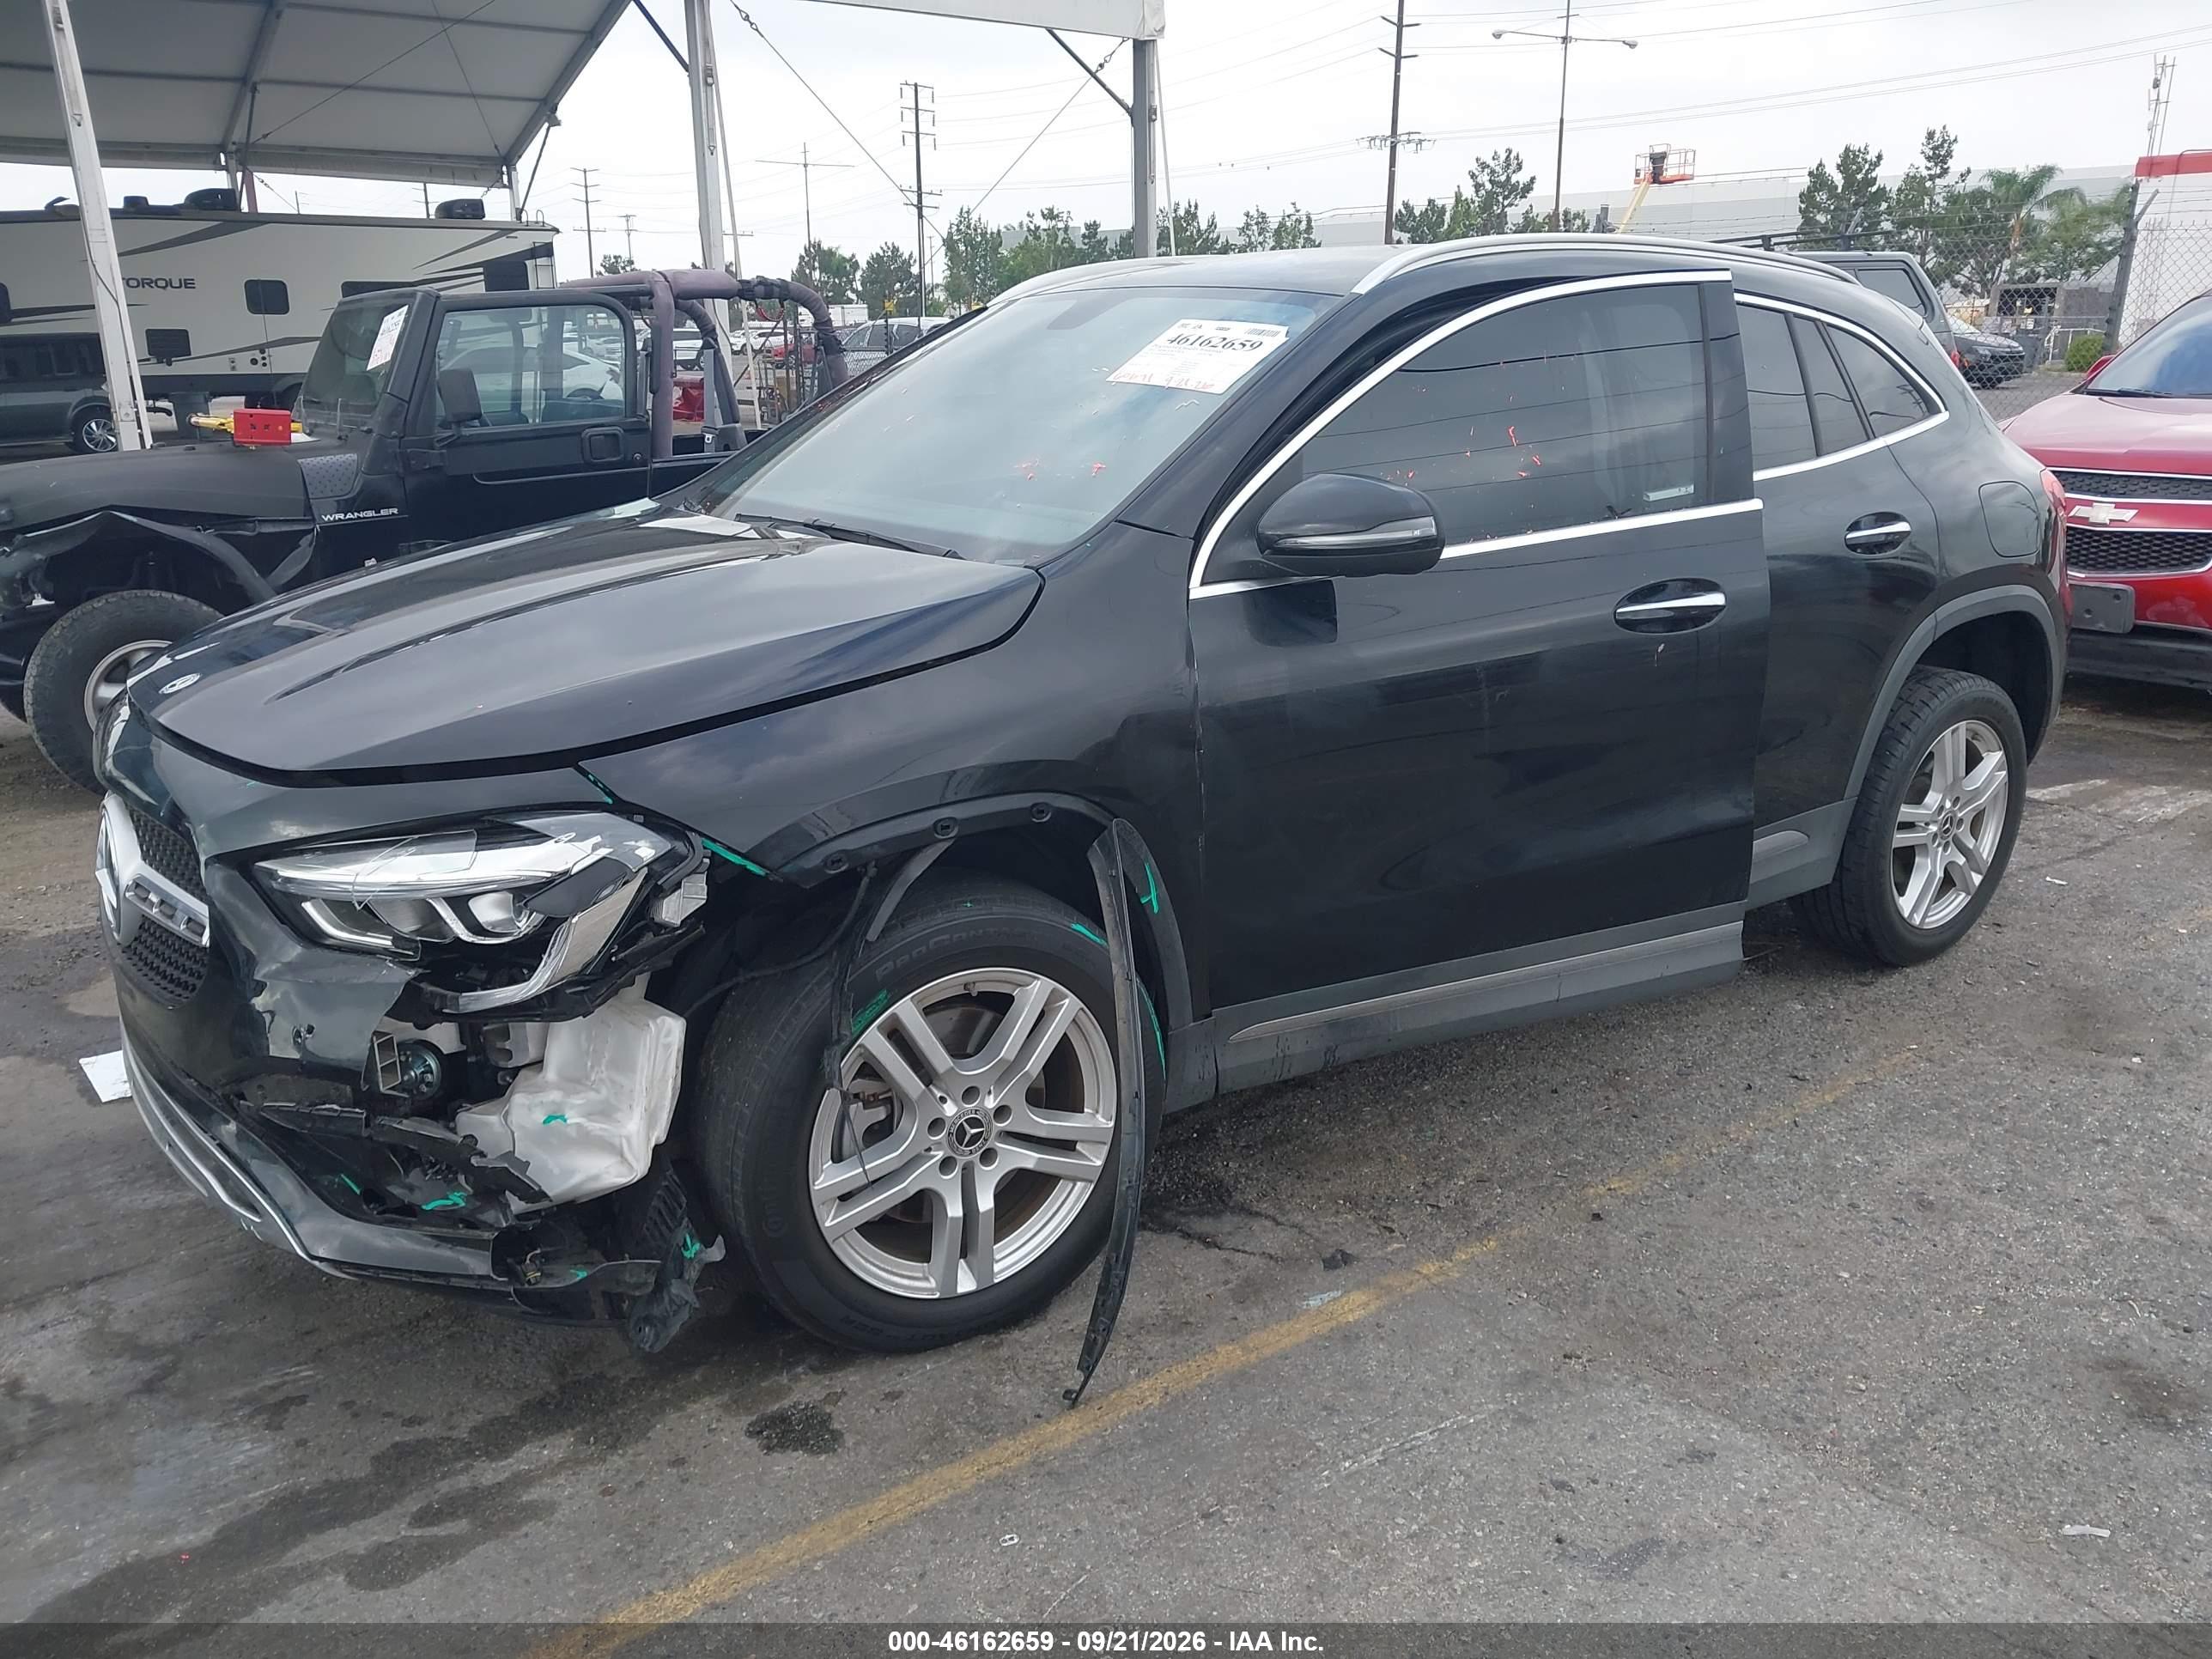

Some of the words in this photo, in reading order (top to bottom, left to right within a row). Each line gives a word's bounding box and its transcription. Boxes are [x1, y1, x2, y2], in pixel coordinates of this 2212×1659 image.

[122, 276, 196, 290] ORQUE
[1167, 333, 1263, 351] 46162659
[321, 507, 399, 522] WRANGLER
